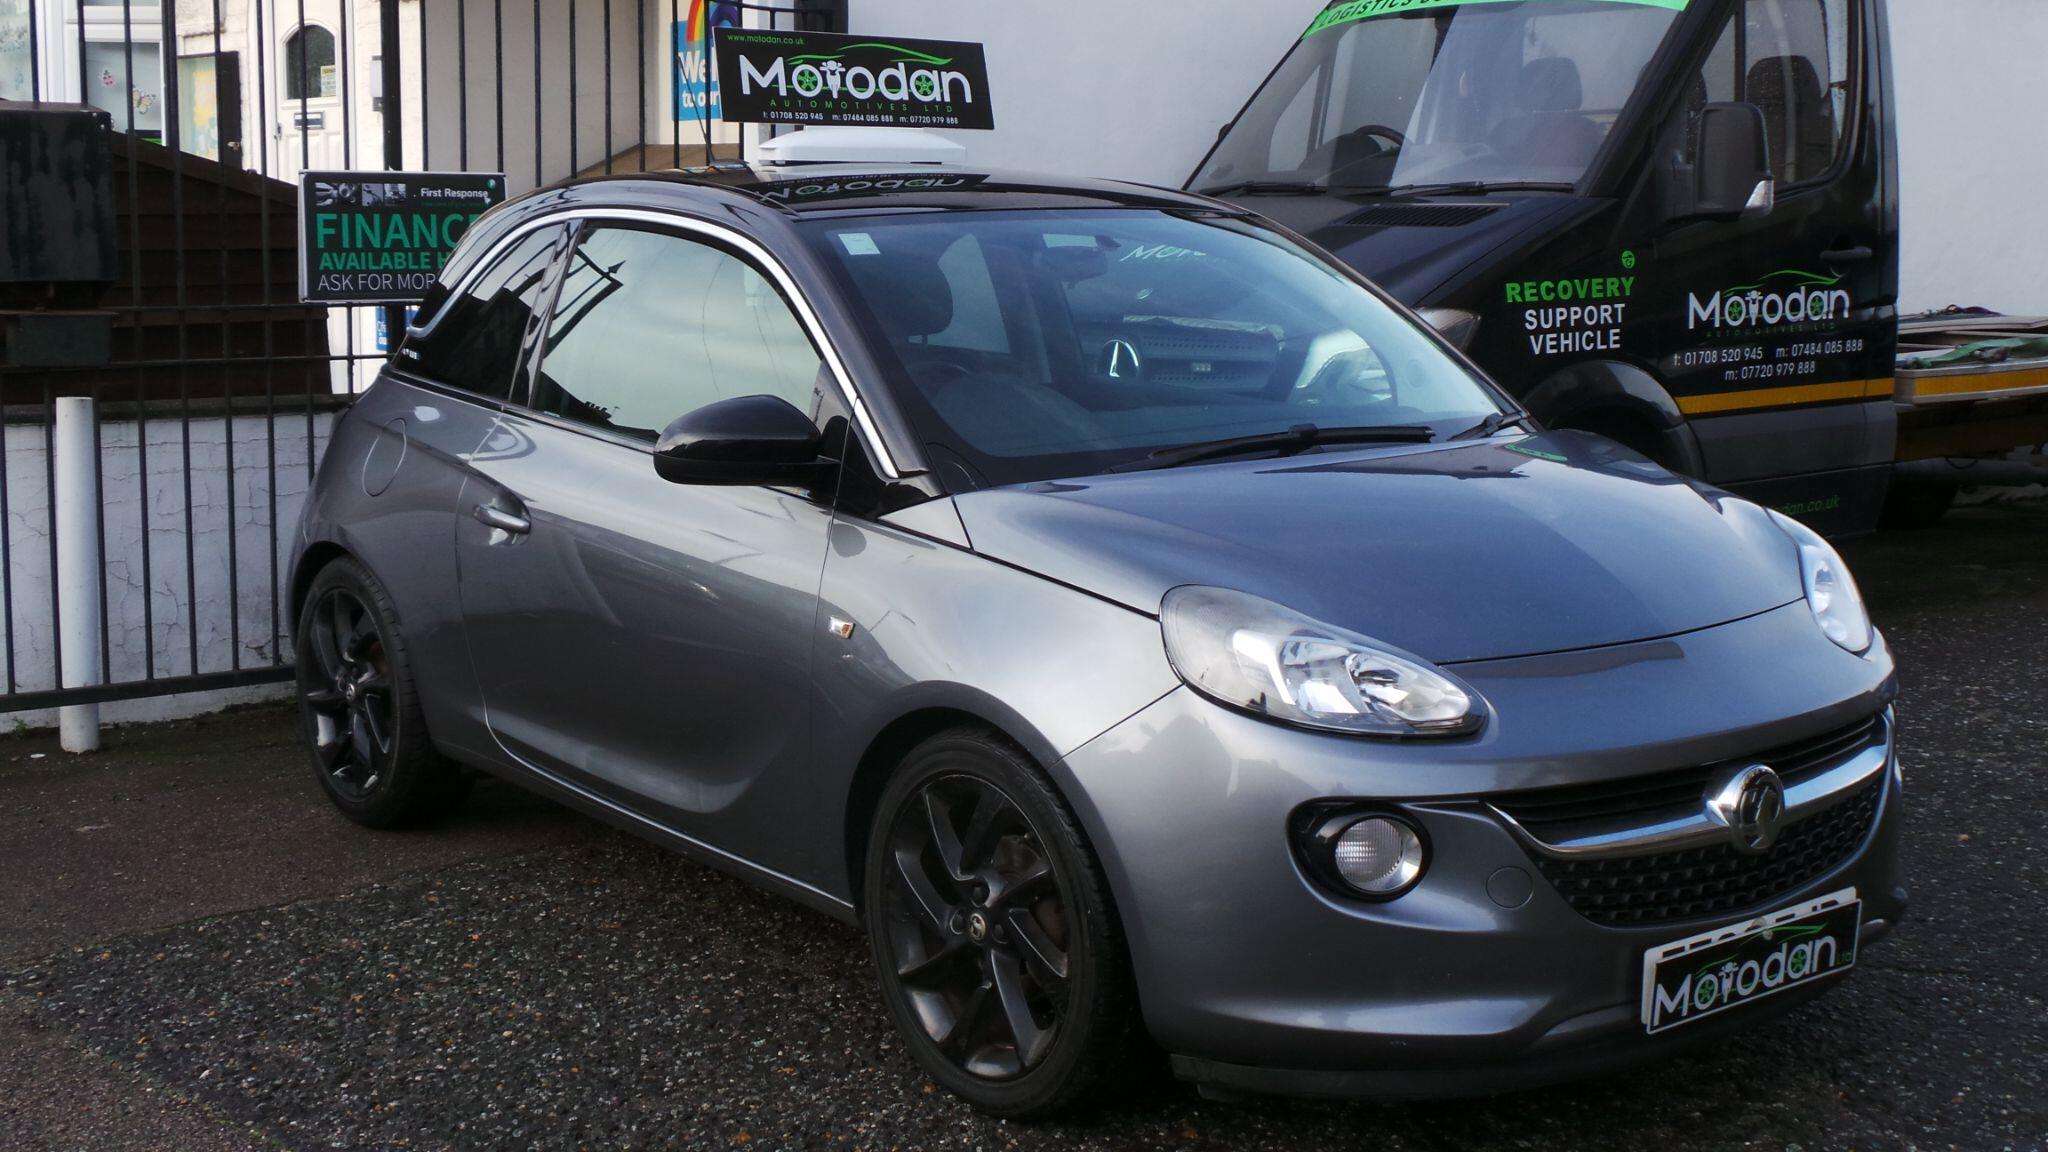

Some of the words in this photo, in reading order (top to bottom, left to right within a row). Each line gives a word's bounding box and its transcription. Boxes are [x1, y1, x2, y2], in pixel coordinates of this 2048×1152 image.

[739, 54, 972, 103] Motodan
[769, 99, 908, 111] AUTOMOTIVES
[924, 105, 953, 113] LTD
[770, 111, 793, 120] 01708
[795, 112, 808, 120] 520
[809, 113, 824, 121] 945
[842, 113, 864, 122] 07484
[866, 114, 879, 122] 085
[909, 115, 931, 124] 07720
[932, 116, 944, 124] 979
[420, 187, 442, 198] First
[444, 187, 489, 200] Response
[319, 252, 432, 271] AVAILABLE
[318, 274, 354, 291] ASK
[358, 274, 393, 291] FOR
[1505, 276, 1635, 303] RECOVERY
[1524, 303, 1626, 331] SUPPORT
[1688, 285, 1850, 330] Motodan
[1530, 328, 1622, 356] VEHICLE
[1684, 350, 1718, 366] 01708
[1721, 348, 1741, 363] 520
[1743, 346, 1764, 361] 945
[1775, 348, 1789, 359] m:
[1791, 342, 1822, 358] 07484
[1824, 340, 1843, 355] 085
[1845, 338, 1864, 353] 888
[1725, 368, 1739, 381] m:
[1741, 364, 1774, 380] 07720
[1776, 362, 1796, 377] 979
[1797, 360, 1816, 375] 888
[1653, 935, 1837, 1027] Motodan
